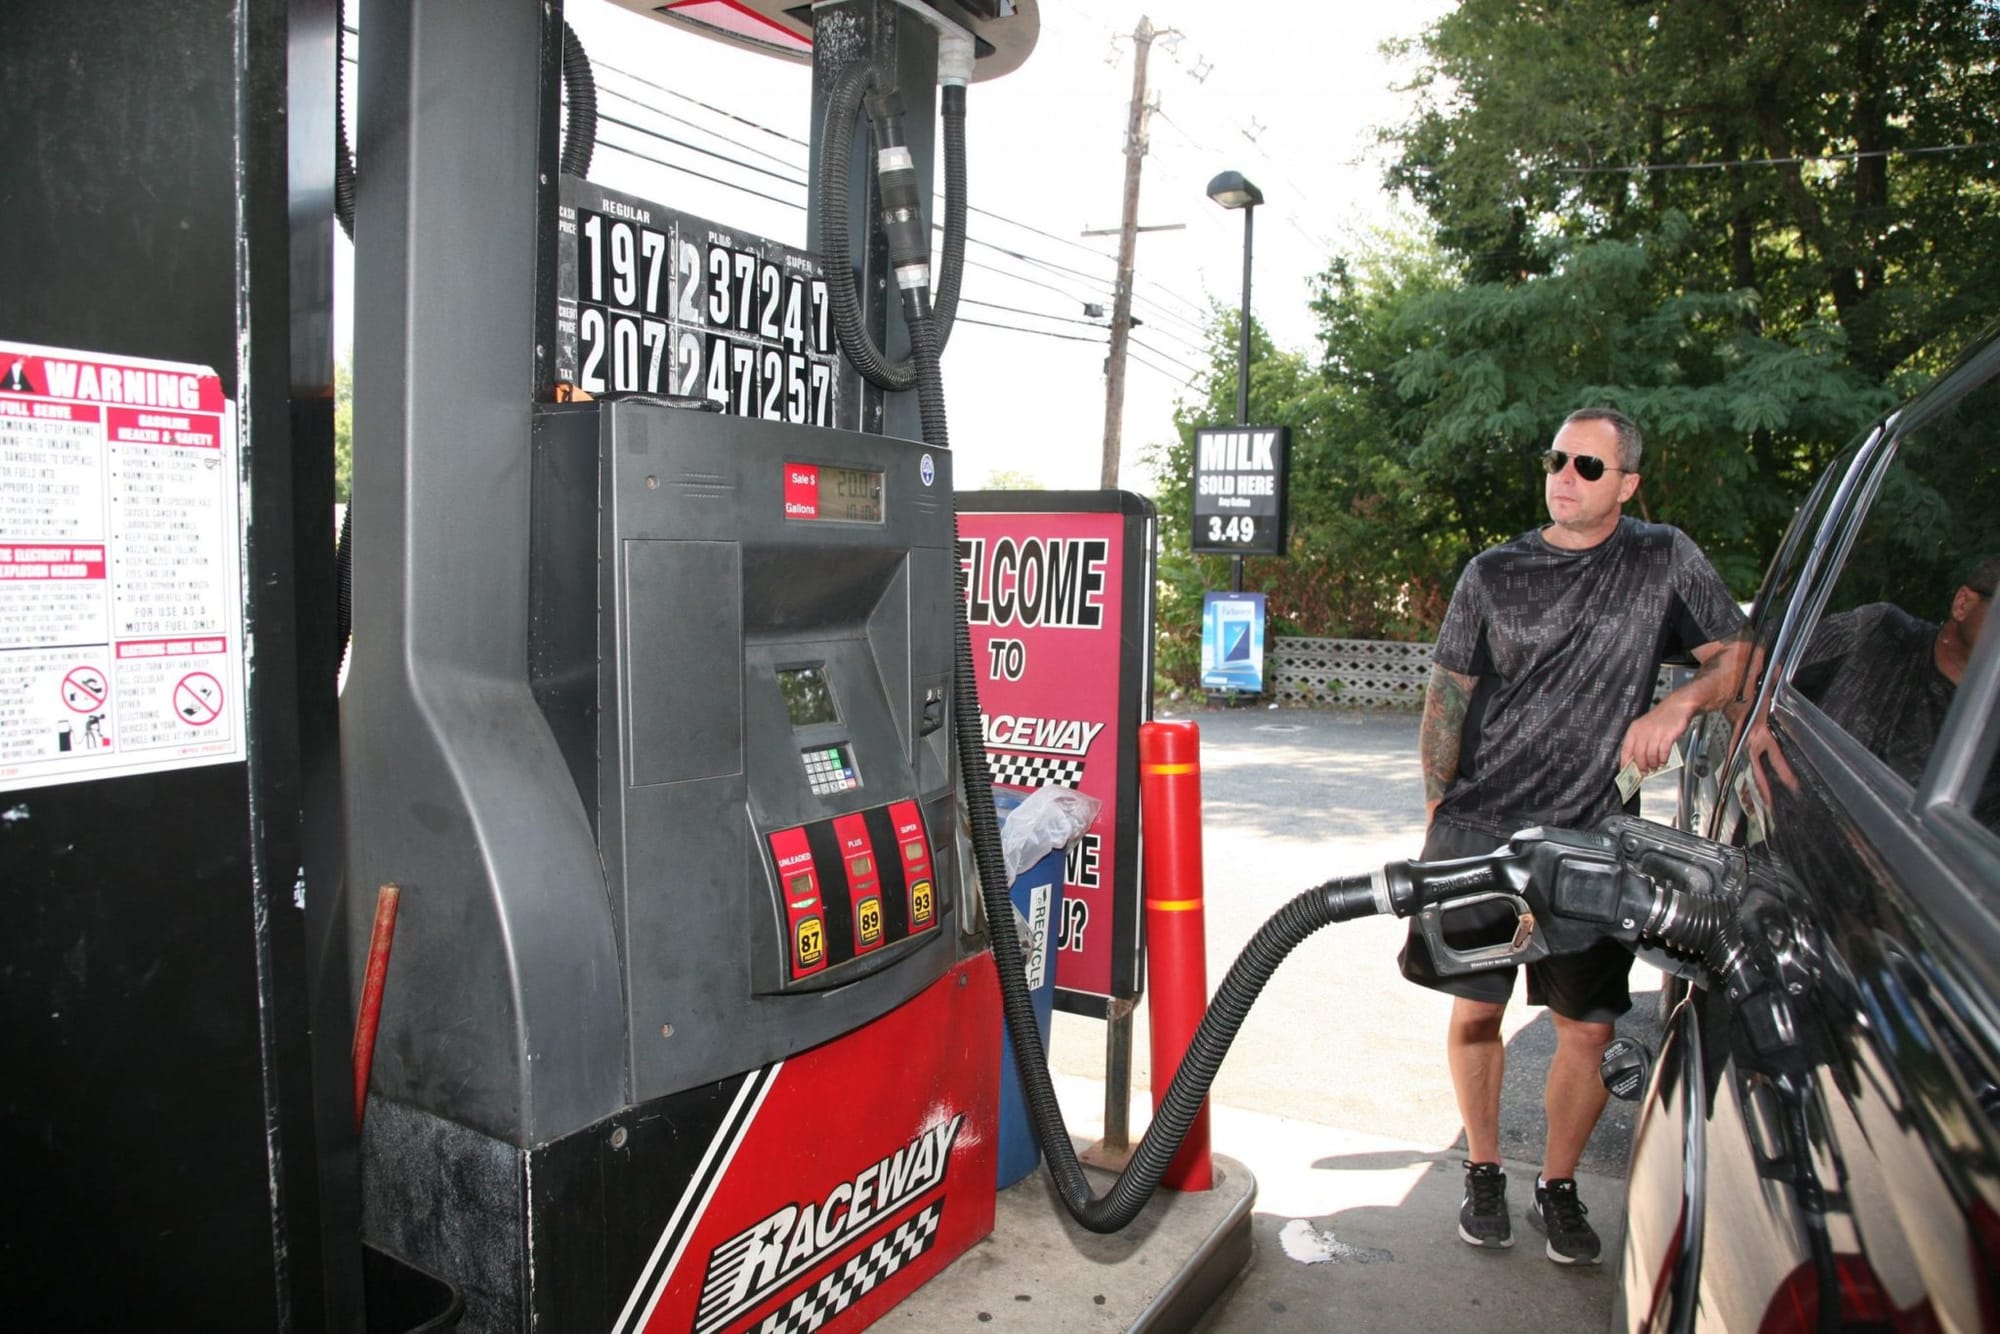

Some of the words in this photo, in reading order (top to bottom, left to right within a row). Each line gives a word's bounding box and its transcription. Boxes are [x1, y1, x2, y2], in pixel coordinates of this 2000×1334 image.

[559, 206, 575, 220] CASH
[602, 199, 650, 224] REGULAR
[559, 220, 576, 235] PRICE
[708, 231, 732, 247] PLUS
[585, 215, 665, 313] 197
[785, 255, 813, 275] SUPER
[581, 309, 666, 393] 207
[44, 361, 200, 410] WARNING
[1201, 433, 1275, 471] MILK
[792, 473, 809, 485] Sale
[1200, 475, 1234, 495] SOLD
[1237, 475, 1274, 495] HERE
[786, 502, 815, 515] Gallons
[1208, 516, 1254, 542] 3.49
[958, 536, 1109, 629] LCOME
[134, 606, 153, 618] FOR
[158, 606, 177, 617] USE
[182, 605, 195, 616] AS
[125, 620, 159, 632] MOTOR
[165, 619, 187, 631] FUEL
[192, 619, 215, 631] ONLY
[988, 638, 1025, 681] TO
[979, 713, 1104, 752] CEWAY
[900, 823, 917, 834] SUPER
[848, 838, 863, 848] PLUS
[778, 853, 811, 867] UNLEADED
[915, 893, 929, 912] 93
[863, 911, 878, 931] 89
[801, 931, 819, 953] 87
[1030, 905, 1046, 989] RECYCLE
[698, 1112, 965, 1324] RACEWAY
